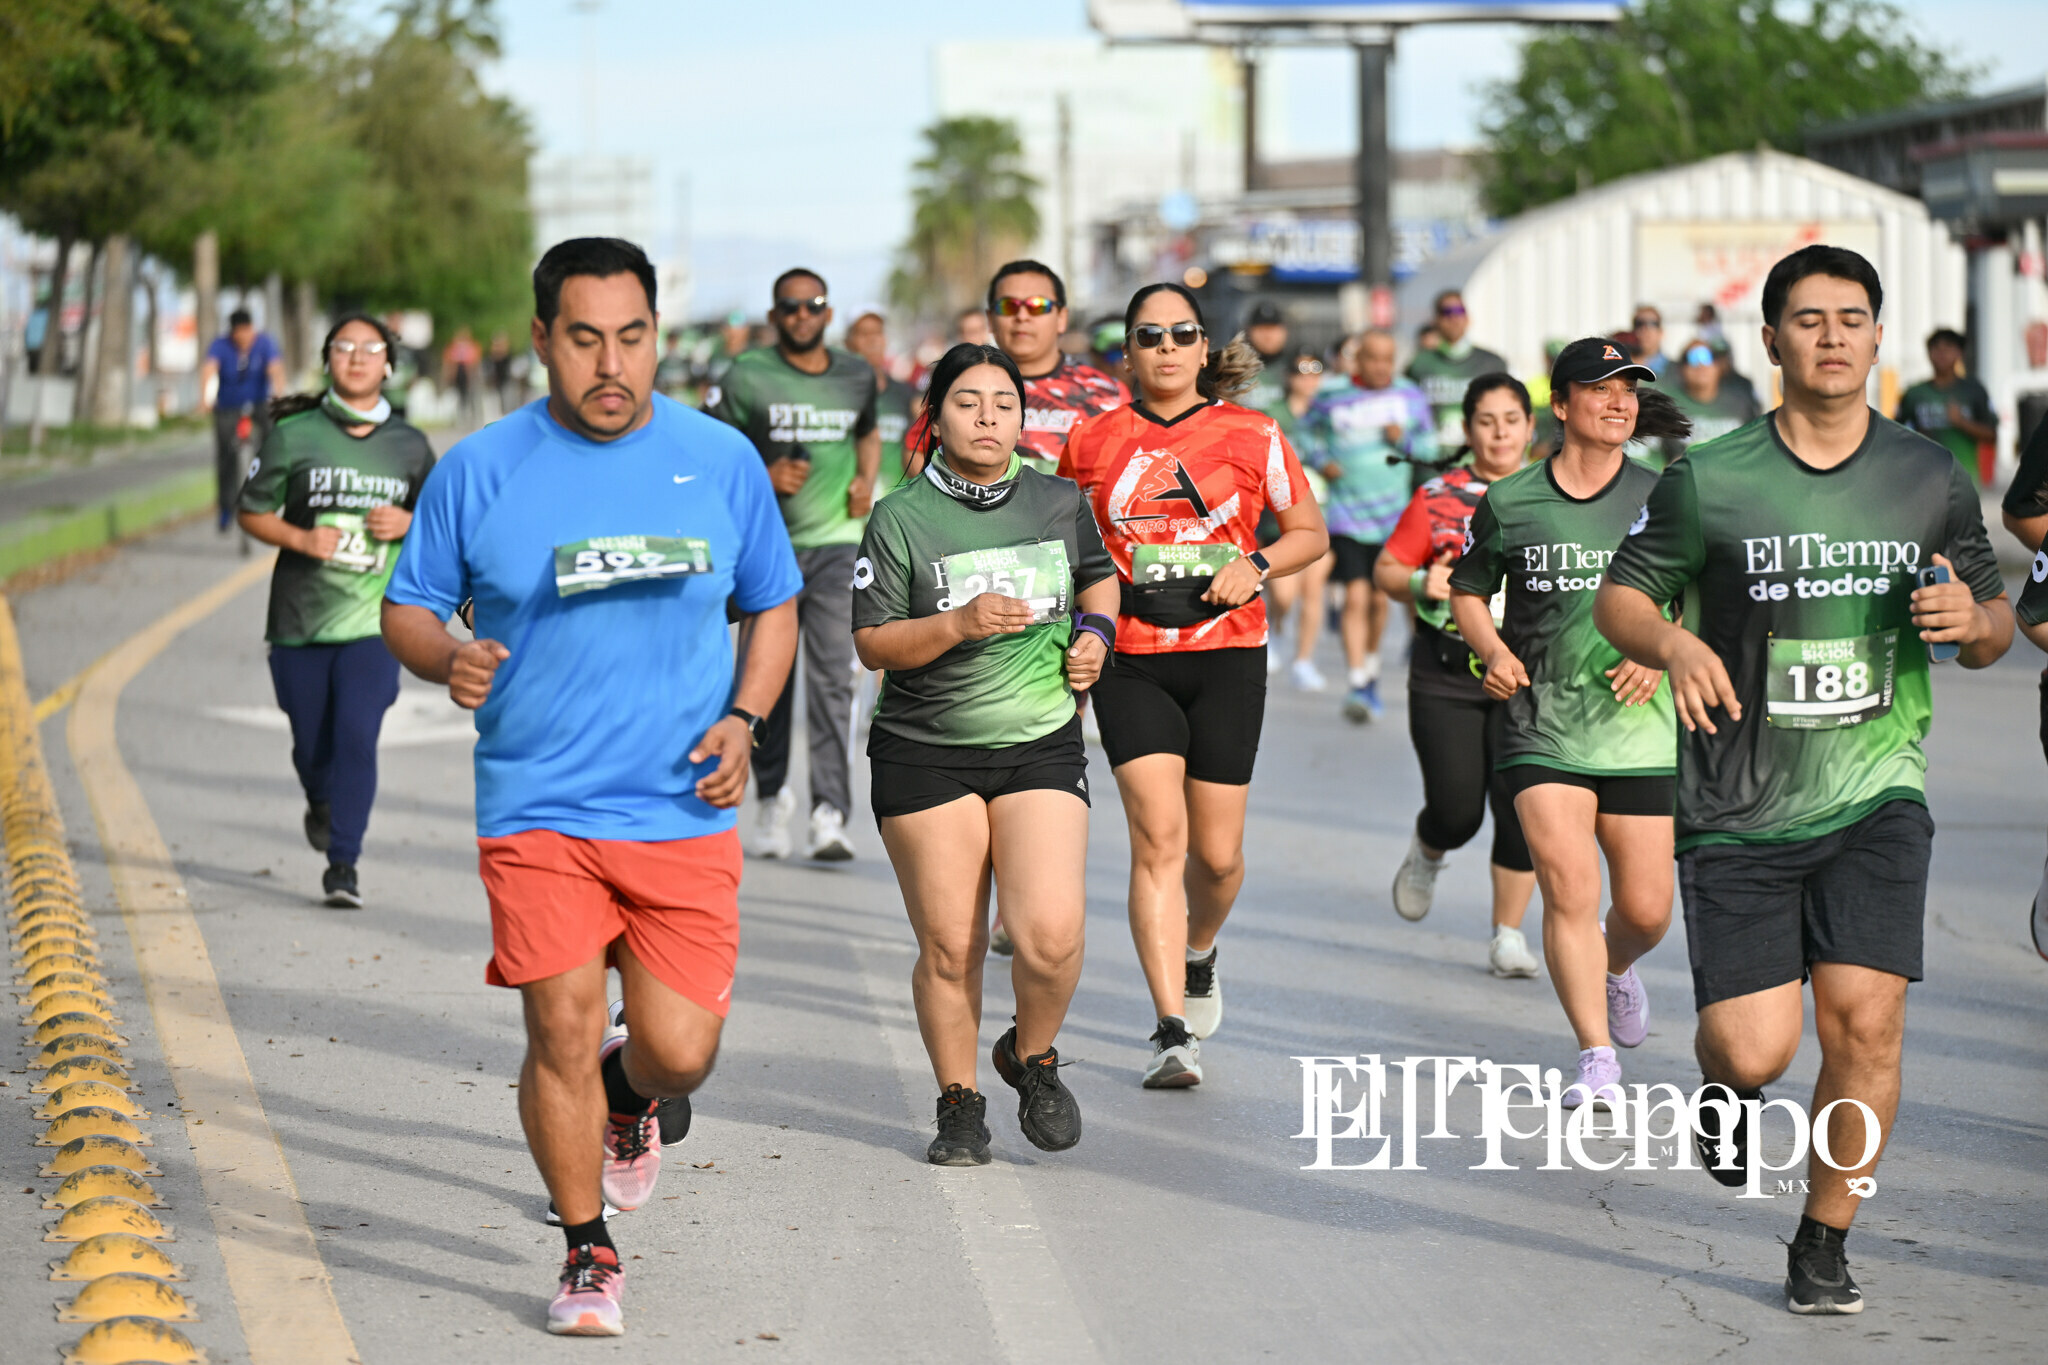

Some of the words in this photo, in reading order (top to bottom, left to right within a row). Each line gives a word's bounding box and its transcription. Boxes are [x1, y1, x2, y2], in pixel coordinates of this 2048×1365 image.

[309, 467, 331, 492] El
[950, 478, 968, 495] El
[308, 493, 333, 507] de
[1117, 521, 1167, 535] ALVARO
[1523, 544, 1549, 572] El
[1742, 535, 1785, 574] El
[1789, 532, 1920, 575] Tiempo
[964, 567, 1037, 604] 257
[1055, 559, 1067, 611] MEDALLA
[1525, 577, 1552, 592] de
[1749, 580, 1790, 601] de
[1794, 573, 1890, 599] todos
[1788, 662, 1869, 701] 188
[1883, 649, 1894, 707] MEDALLA
